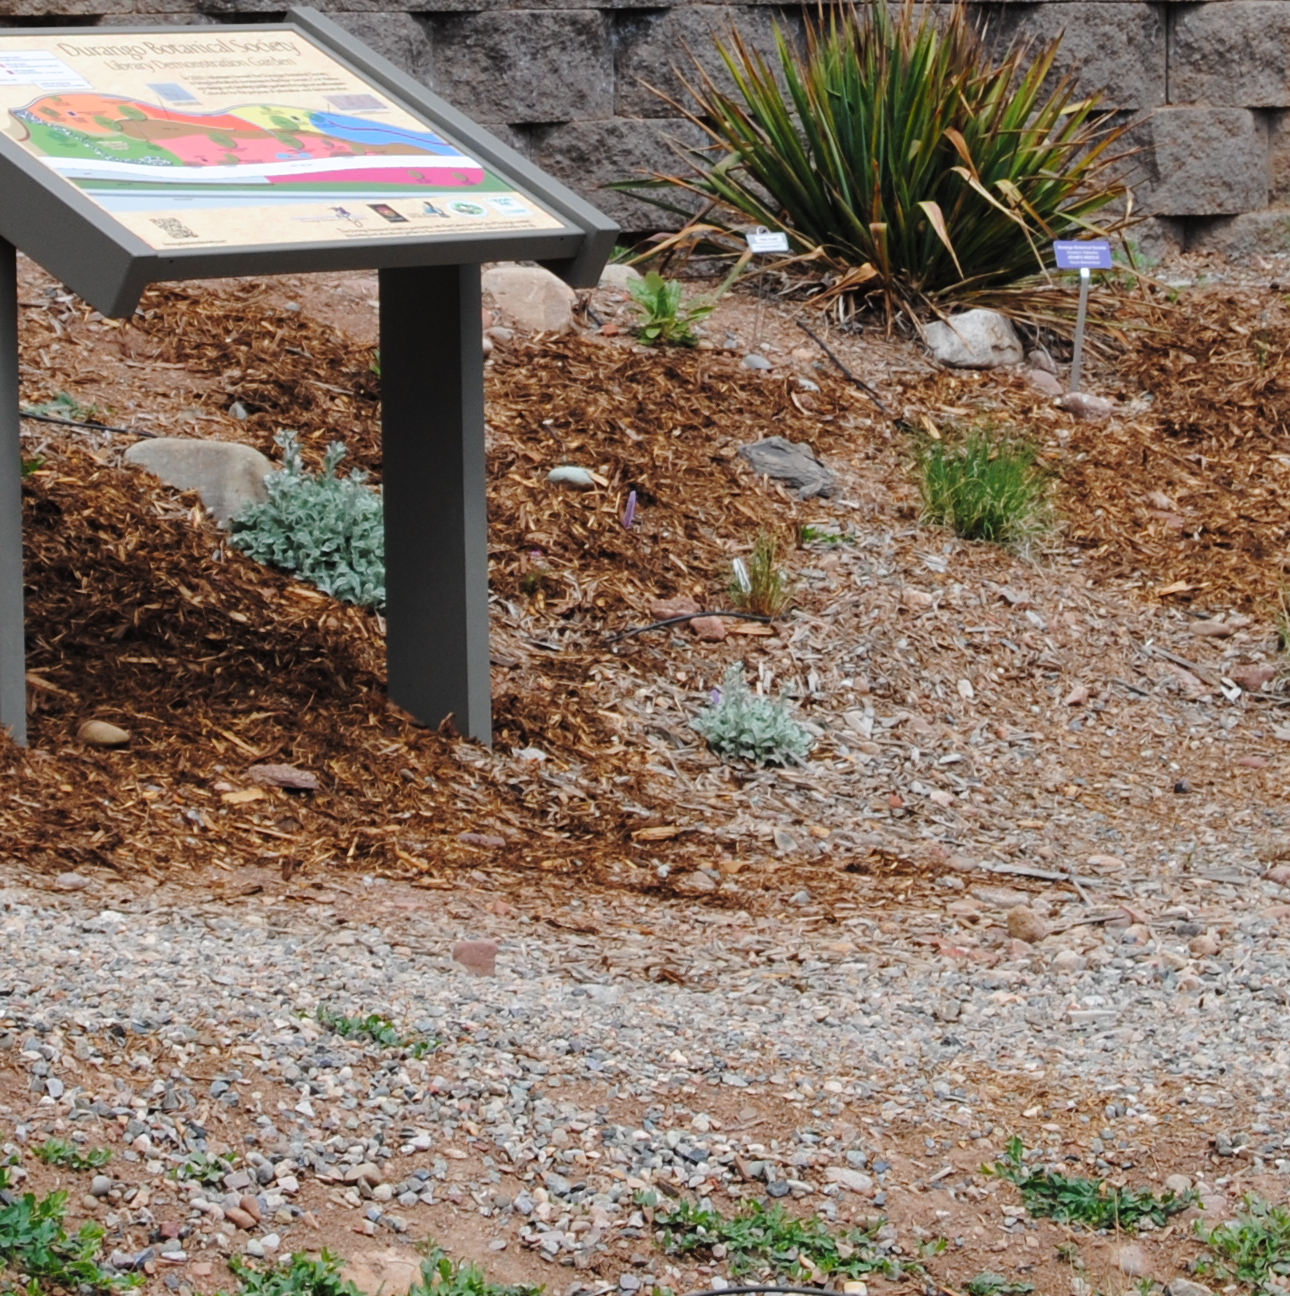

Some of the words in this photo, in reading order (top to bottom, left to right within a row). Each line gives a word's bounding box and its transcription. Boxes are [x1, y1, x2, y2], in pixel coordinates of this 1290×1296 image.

[57, 42, 147, 60] Durango
[143, 39, 229, 55] Botanical
[231, 38, 302, 56] Society
[104, 61, 155, 73] Library
[153, 58, 247, 70] Demonstration
[248, 56, 297, 67] Garden
